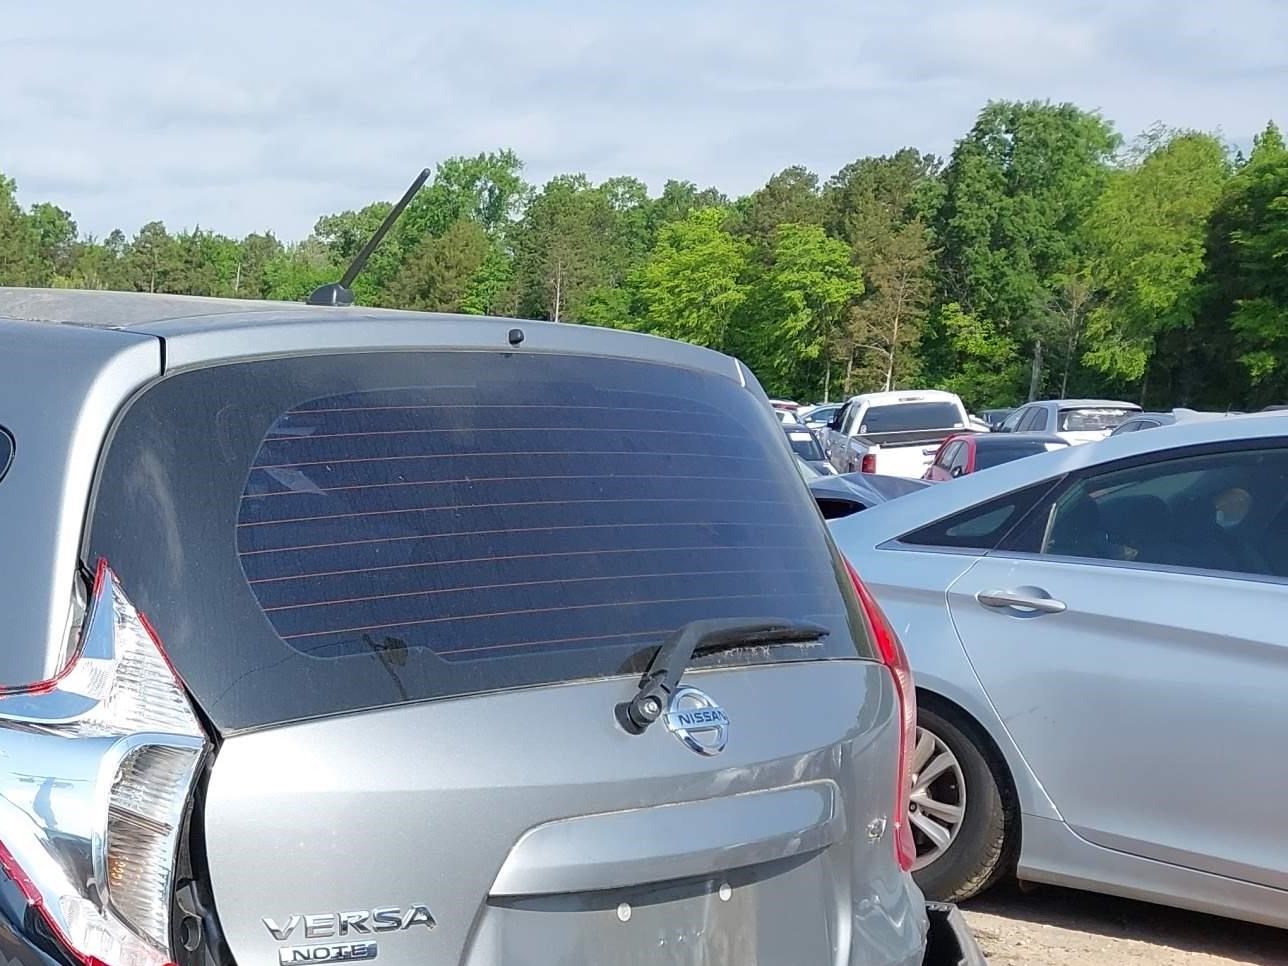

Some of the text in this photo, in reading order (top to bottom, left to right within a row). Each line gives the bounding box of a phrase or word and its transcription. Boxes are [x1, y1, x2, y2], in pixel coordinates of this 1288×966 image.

[678, 710, 727, 726] NISSAN
[262, 903, 437, 941] VERSA
[292, 943, 367, 962] NOTE
